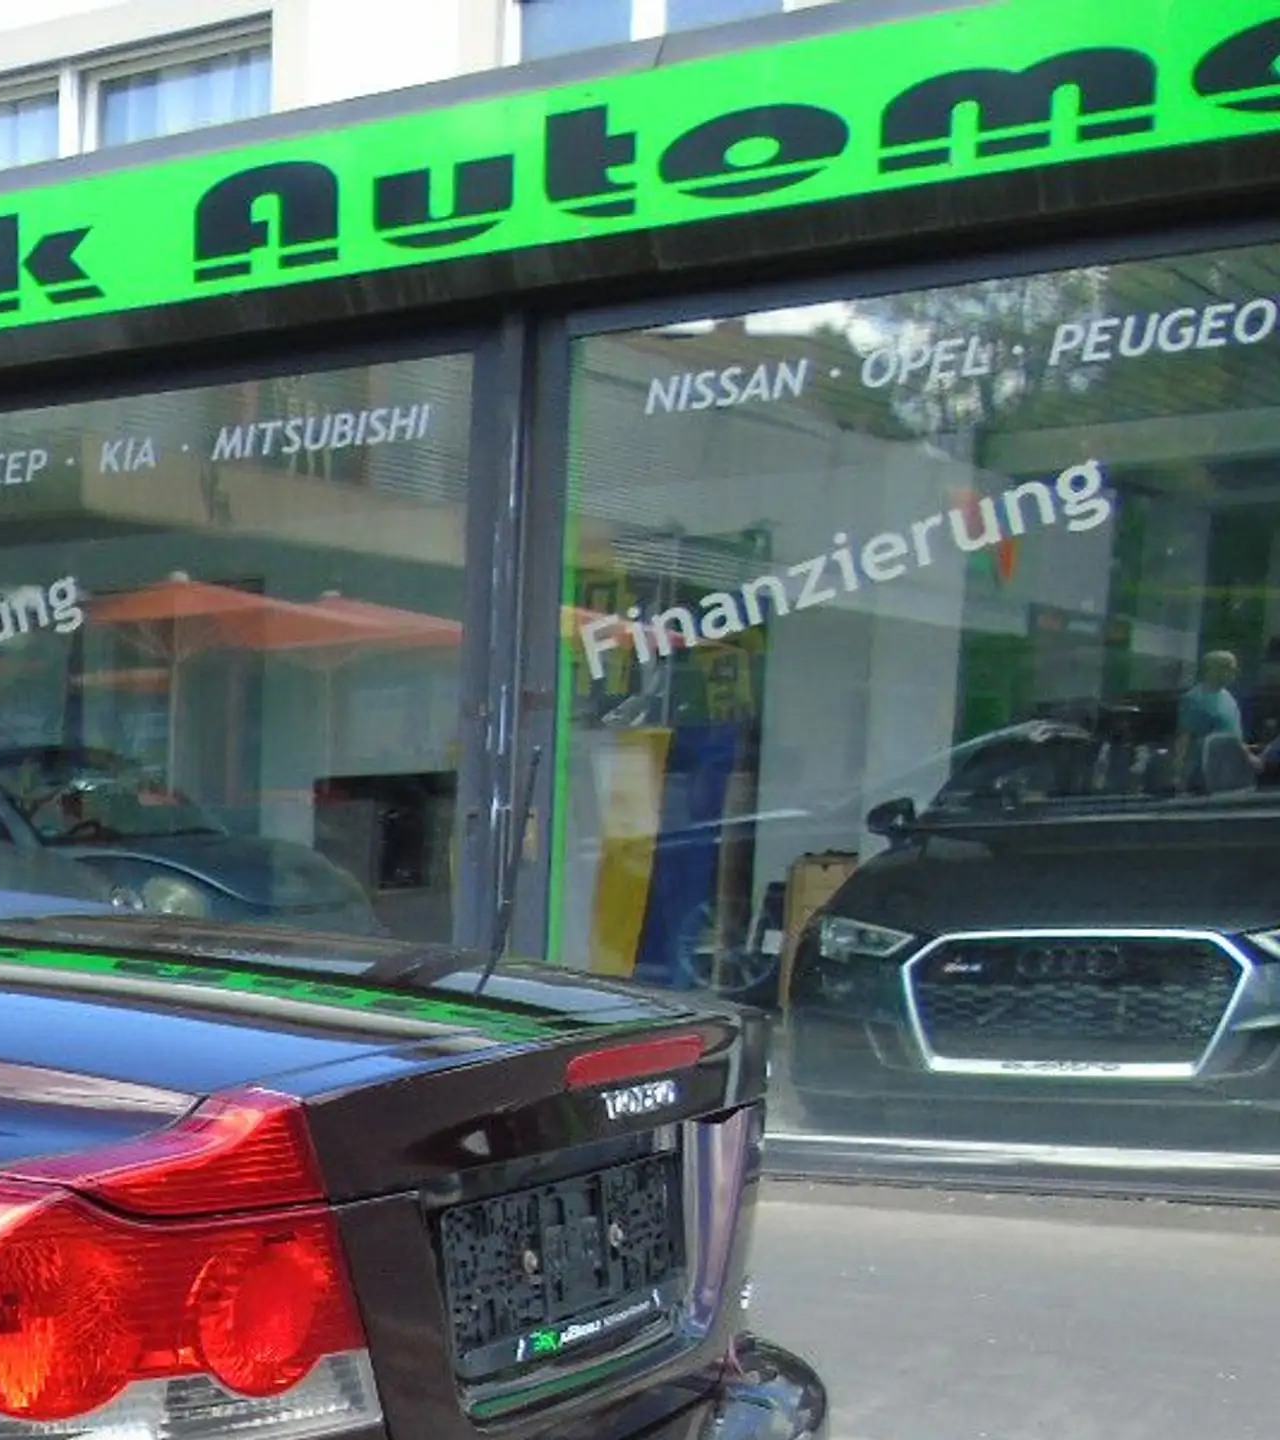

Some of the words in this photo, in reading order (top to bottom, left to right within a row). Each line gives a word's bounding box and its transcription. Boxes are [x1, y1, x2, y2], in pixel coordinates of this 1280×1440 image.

[643, 358, 809, 416] NISSAN
[860, 337, 992, 389] OPEL
[1047, 297, 1278, 367] PEUGEO
[98, 435, 157, 474] KIA
[210, 402, 432, 461] MITSUBISHI
[578, 457, 1118, 681] Finanzierung
